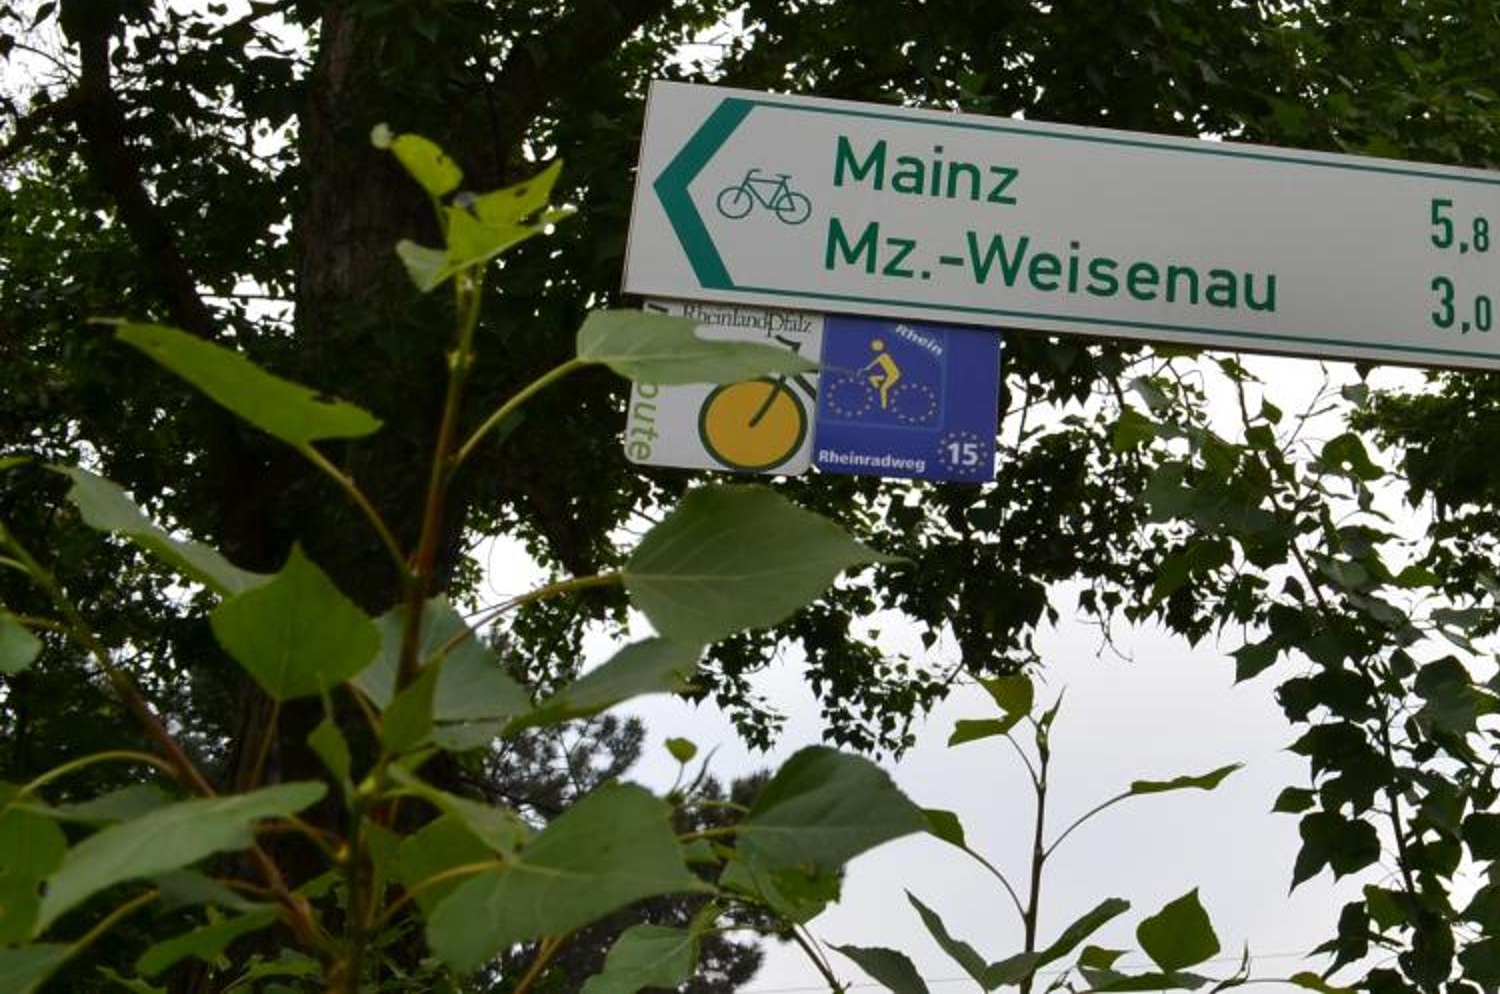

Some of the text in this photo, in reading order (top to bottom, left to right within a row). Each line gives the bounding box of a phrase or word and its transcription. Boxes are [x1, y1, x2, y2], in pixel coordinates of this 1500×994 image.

[833, 136, 1489, 255] Mainz 5,8
[824, 219, 1492, 335] Mz.-Weisenau 3,0
[895, 324, 944, 356] Rhein
[819, 449, 926, 472] Rheinradweg
[946, 442, 979, 465] 15
